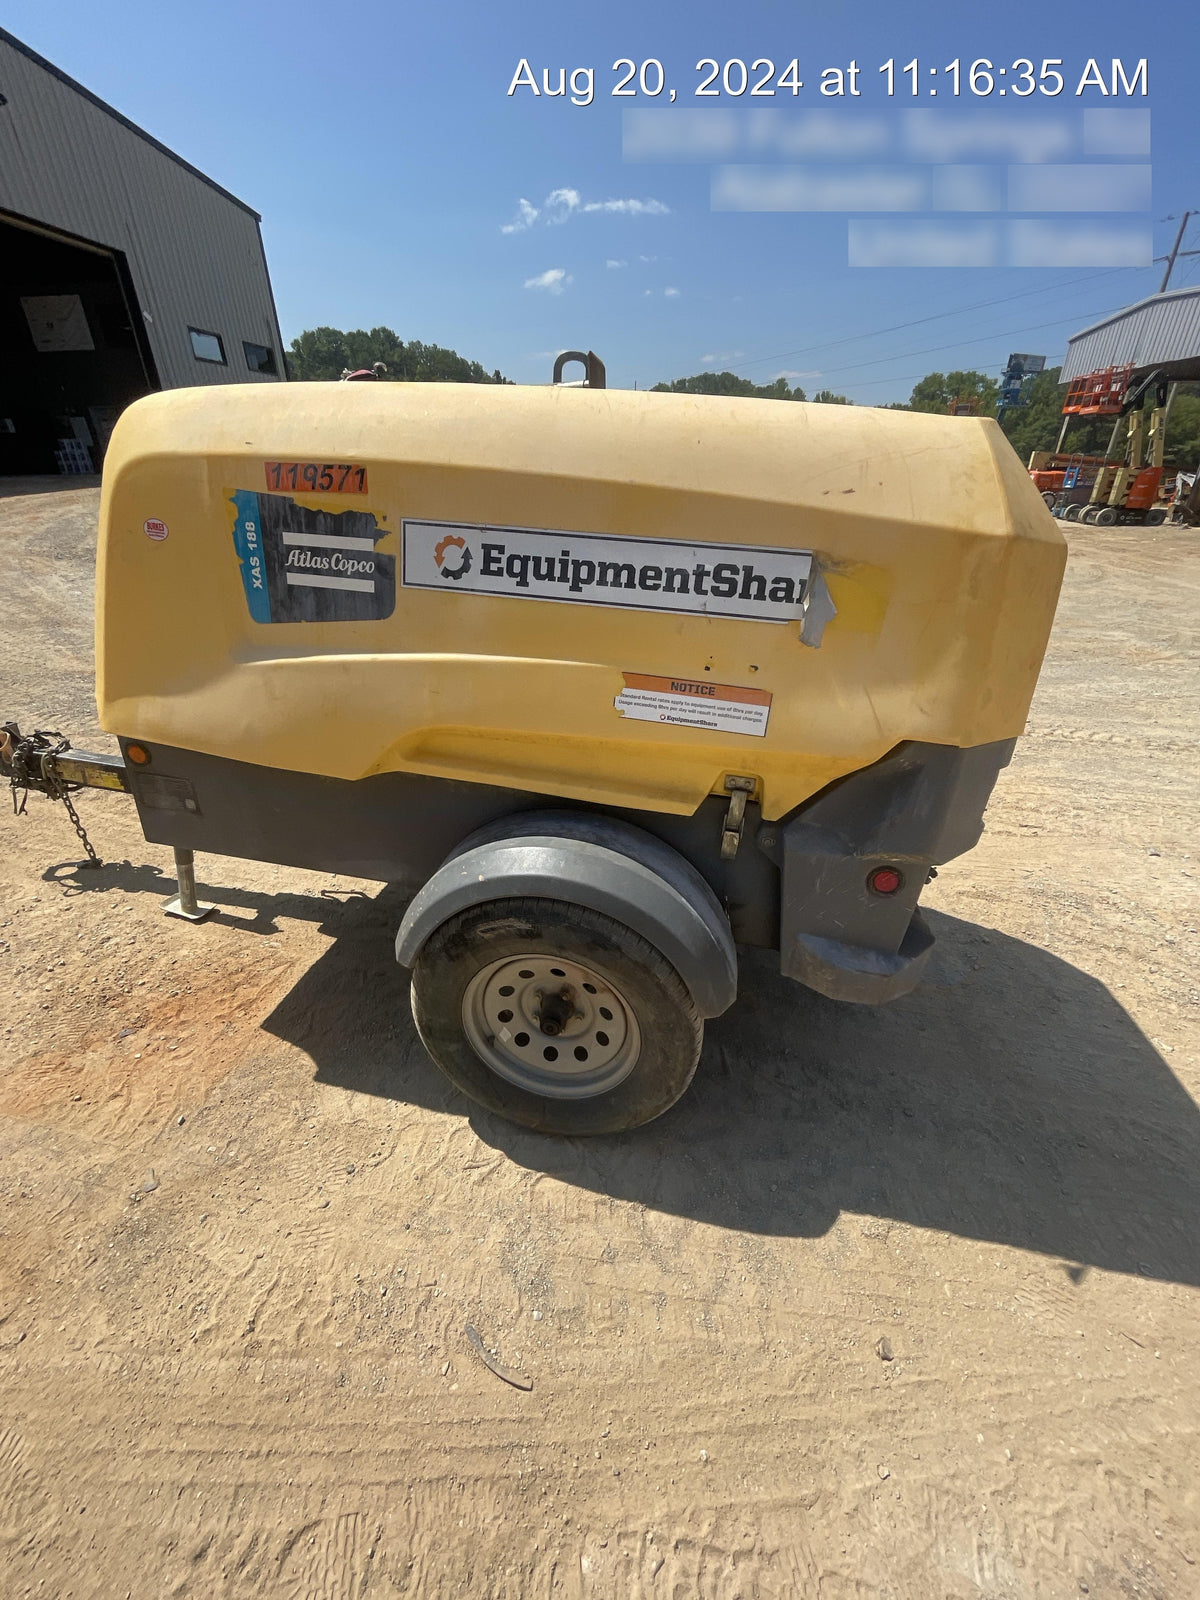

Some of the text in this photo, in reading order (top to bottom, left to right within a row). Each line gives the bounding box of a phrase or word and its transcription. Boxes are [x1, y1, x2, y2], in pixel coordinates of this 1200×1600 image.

[271, 463, 366, 492] 119571
[245, 522, 263, 589] XAS 188
[285, 549, 374, 575] Atlas Copco
[671, 681, 716, 696] NOTICE
[667, 715, 717, 727] EquipmentShare
